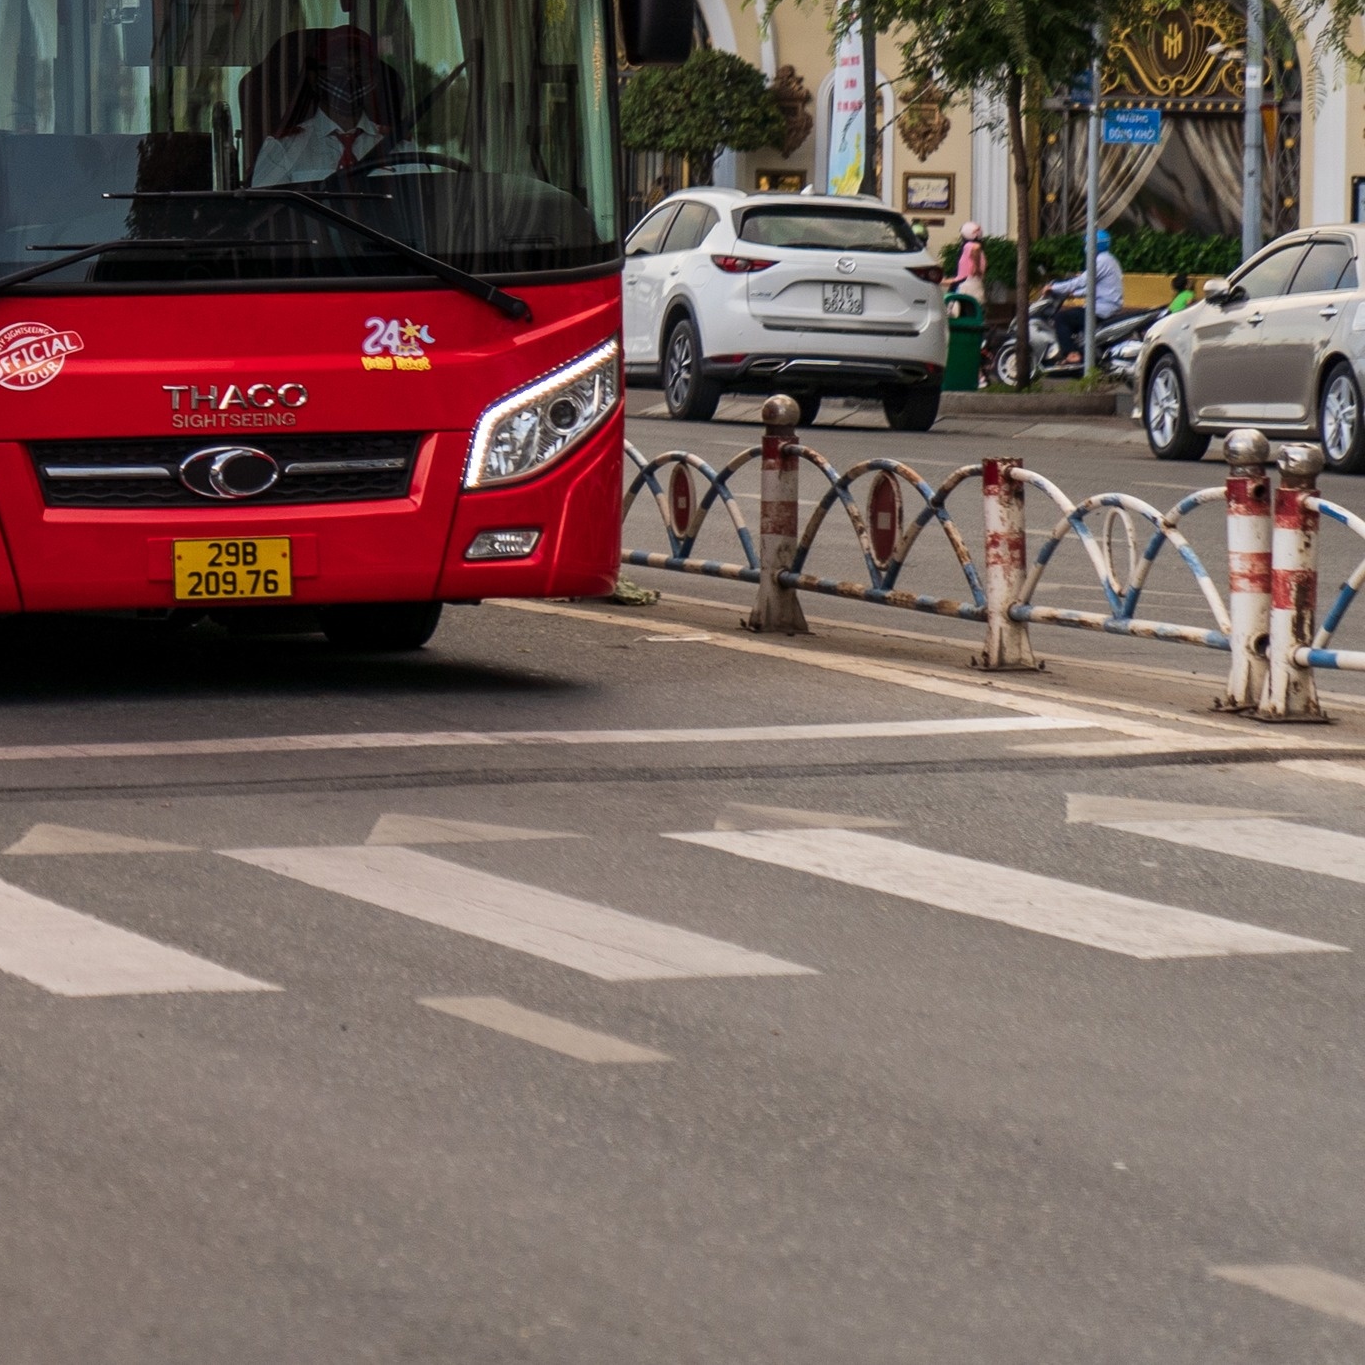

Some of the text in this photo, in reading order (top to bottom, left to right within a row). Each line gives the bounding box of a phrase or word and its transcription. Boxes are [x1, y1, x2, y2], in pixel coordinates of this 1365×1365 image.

[4, 326, 50, 342] SIGHTSEEING
[18, 361, 59, 385] TOUR
[161, 383, 309, 410] THACO
[172, 413, 297, 429] SIGHTSEEING
[207, 542, 257, 568] 29B
[187, 571, 279, 597] 209.76
